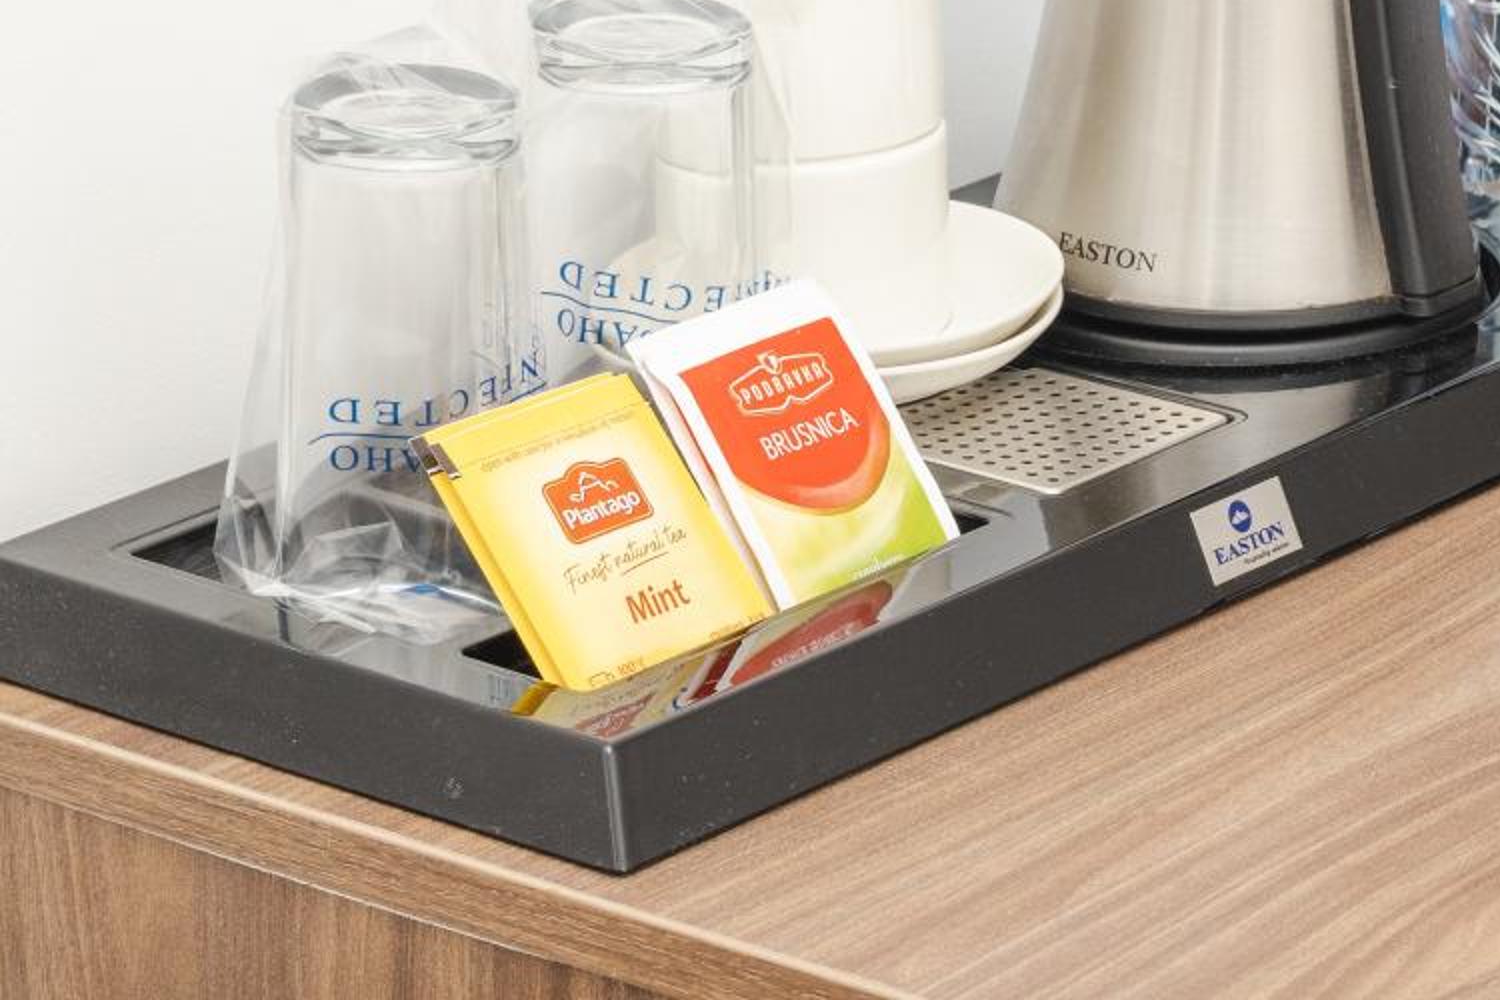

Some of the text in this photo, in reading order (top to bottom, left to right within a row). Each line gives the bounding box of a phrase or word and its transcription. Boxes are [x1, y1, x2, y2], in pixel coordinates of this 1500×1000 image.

[1059, 231, 1158, 273] EASTON
[759, 407, 860, 460] BRUSNICA
[562, 490, 642, 530] Plantago
[1213, 521, 1285, 567] EASTON
[562, 553, 611, 596] Finest
[624, 579, 691, 624] Mint
